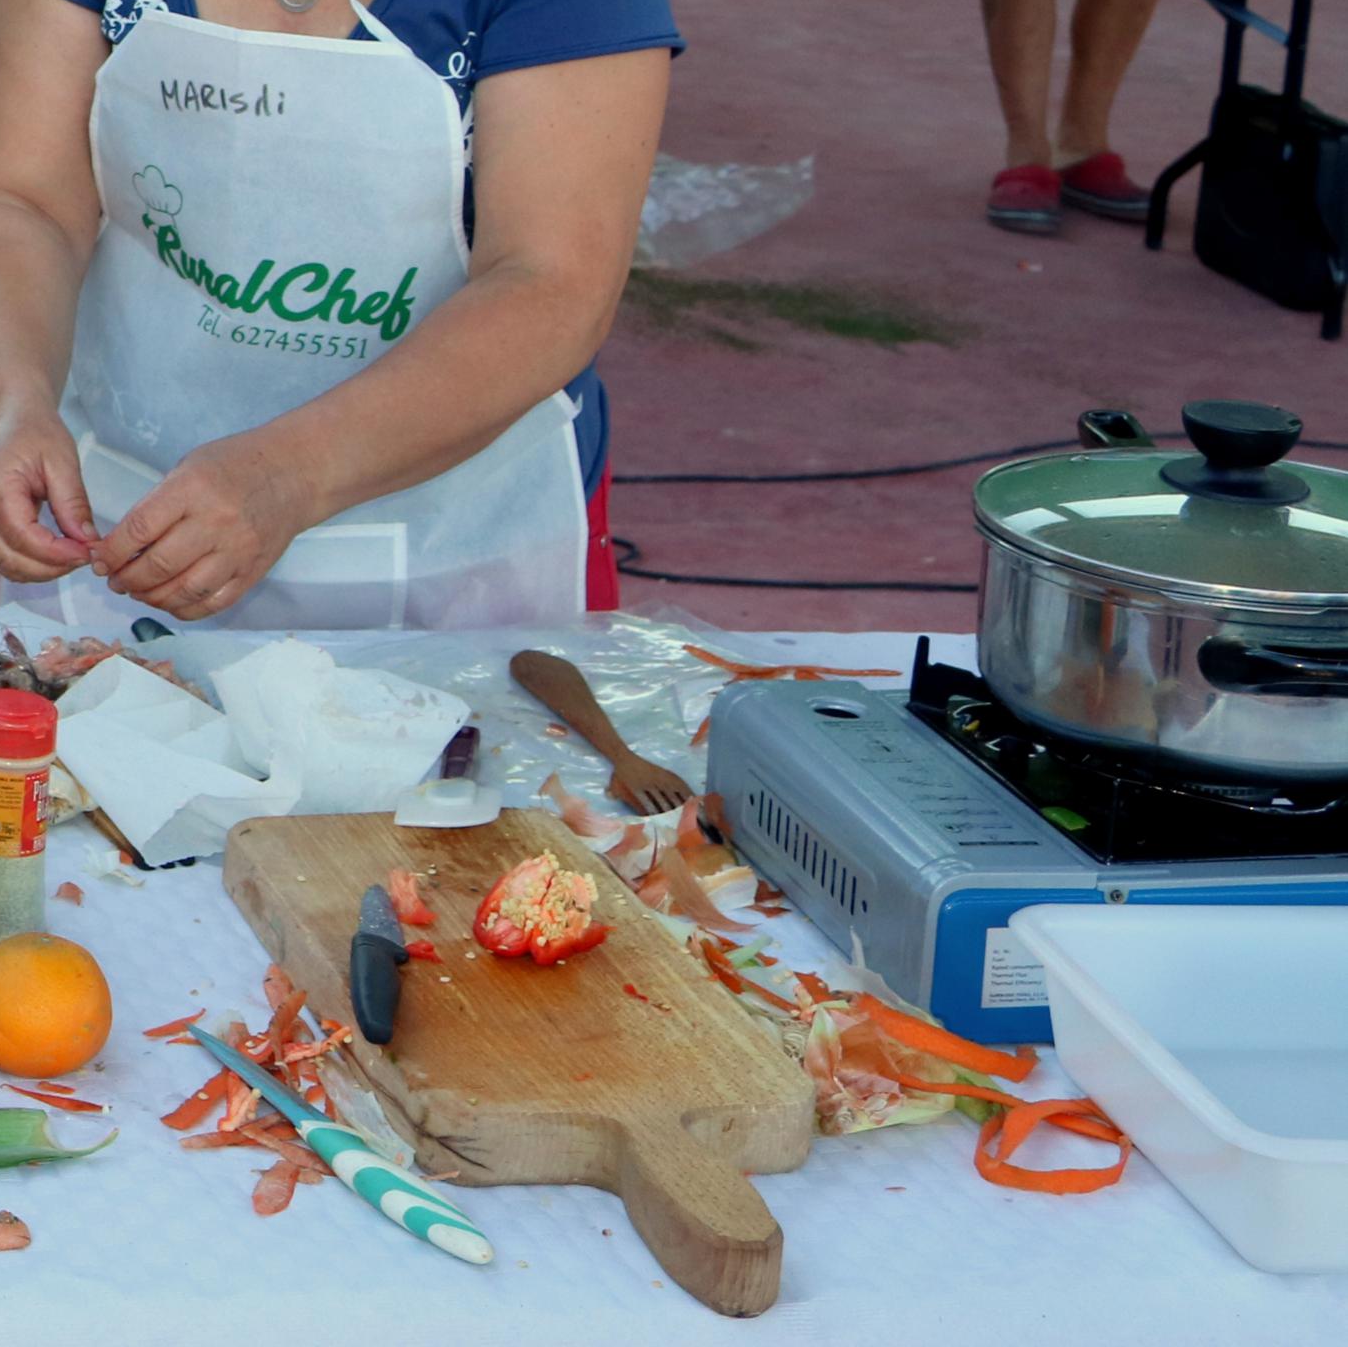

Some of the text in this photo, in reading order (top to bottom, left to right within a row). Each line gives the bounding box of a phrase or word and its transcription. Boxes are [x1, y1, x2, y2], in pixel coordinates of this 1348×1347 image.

[142, 213, 419, 342] RuralChef
[197, 303, 369, 360] Tel. 627455551
